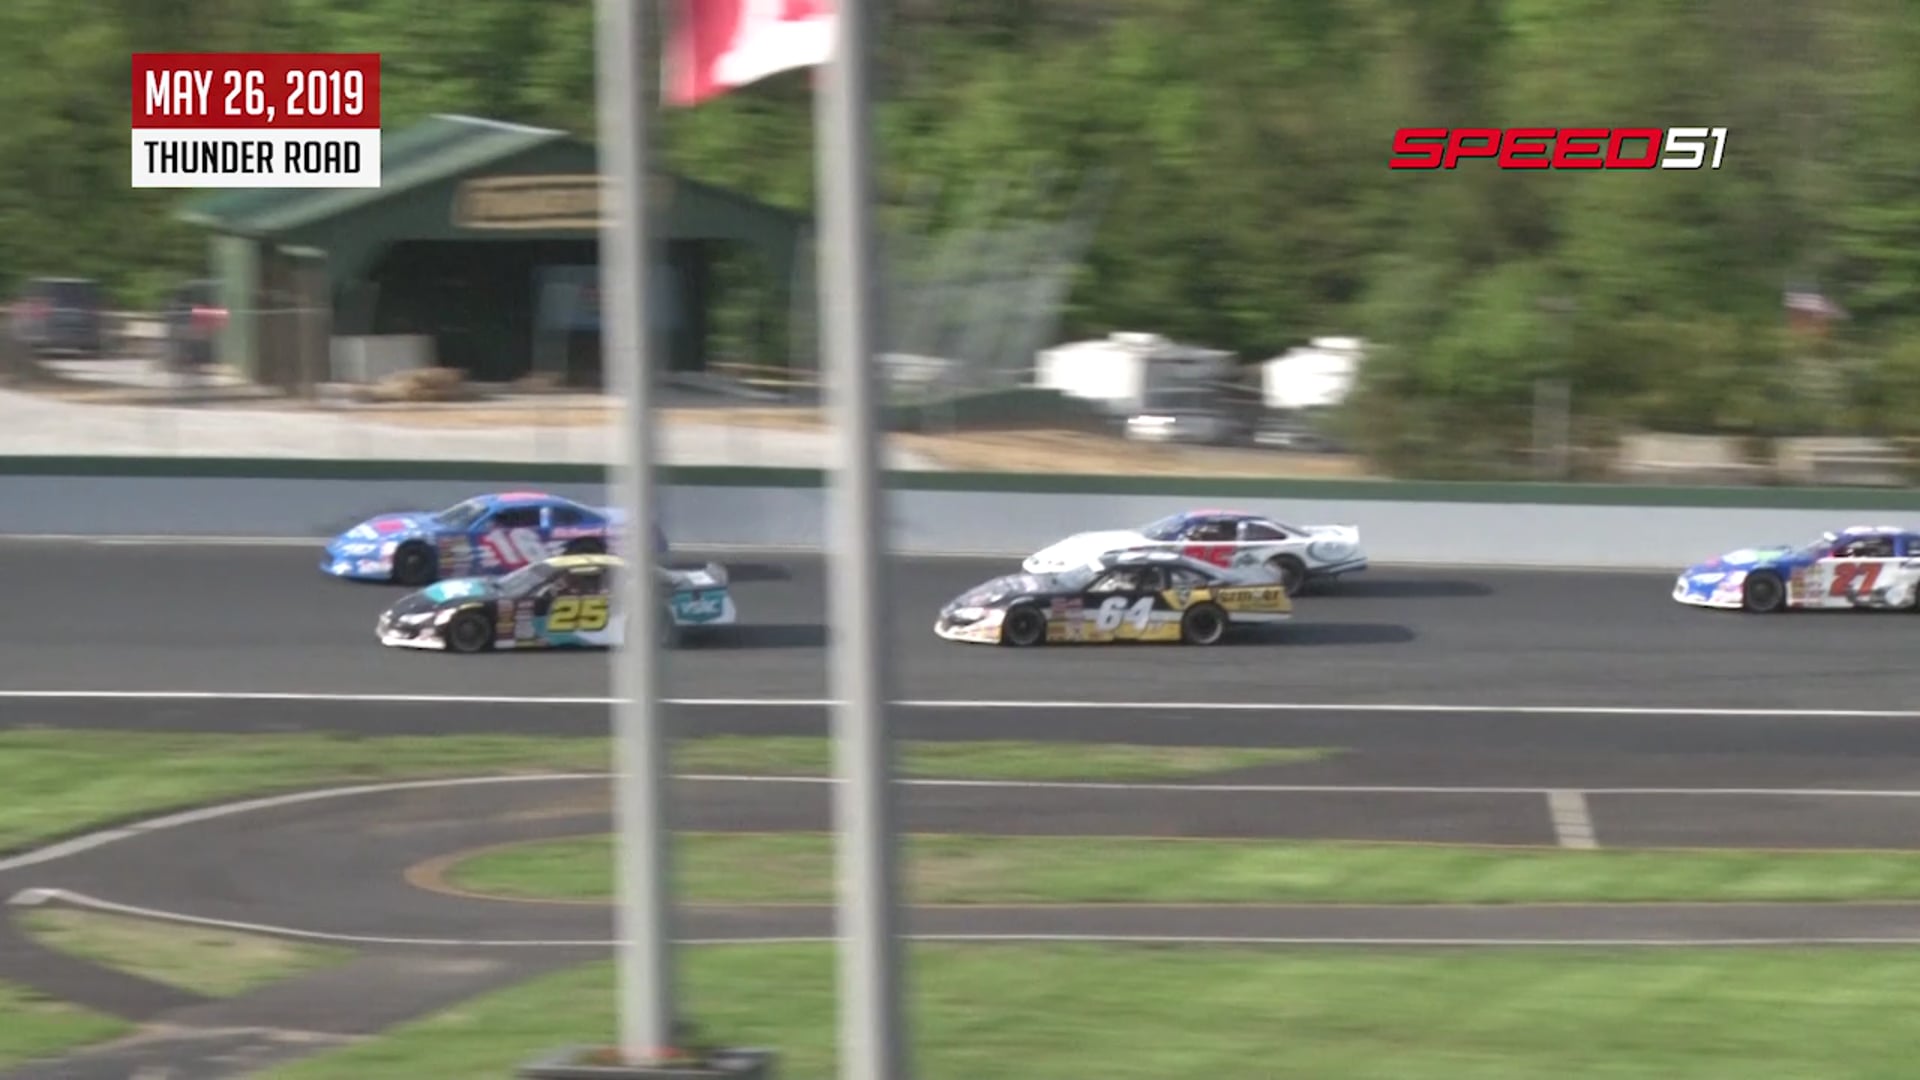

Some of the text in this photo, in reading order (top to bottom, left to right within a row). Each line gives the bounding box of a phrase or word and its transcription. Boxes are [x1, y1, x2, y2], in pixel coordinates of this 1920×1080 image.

[483, 528, 544, 567] 16
[1830, 562, 1884, 597] 27
[549, 597, 608, 632] 25
[1096, 596, 1155, 631] 64
